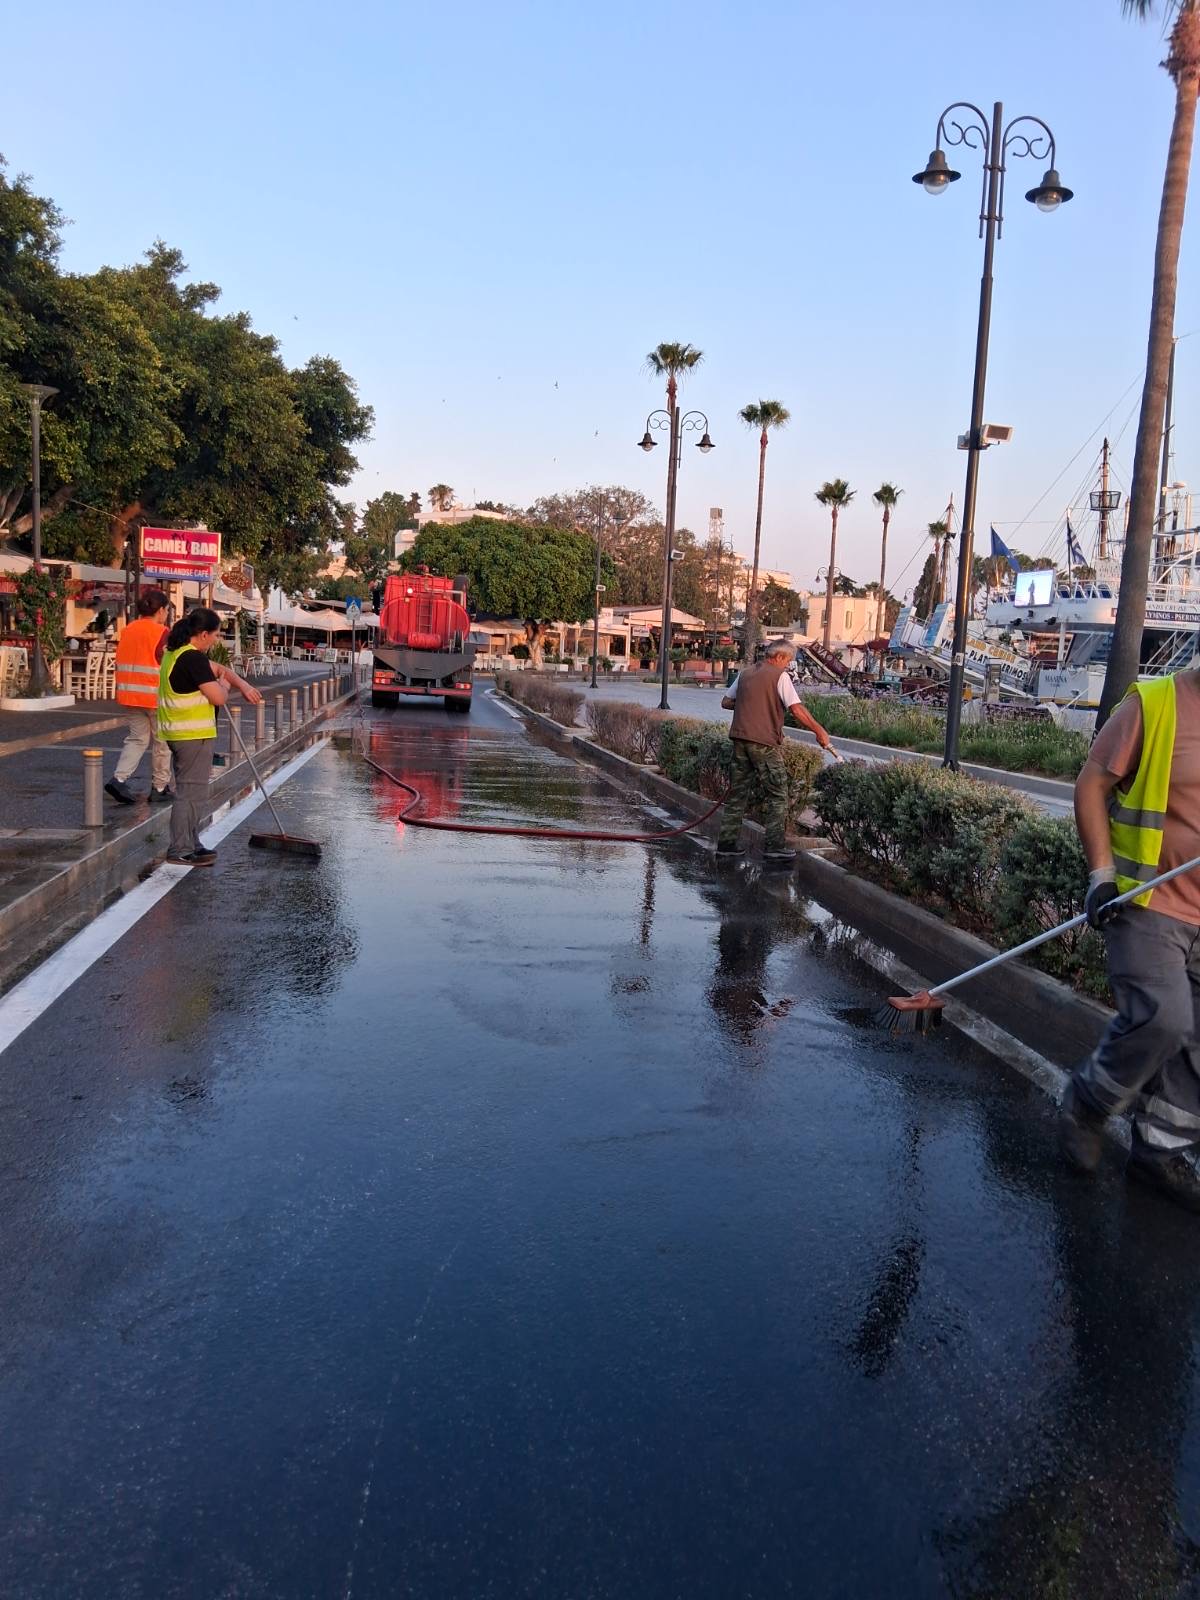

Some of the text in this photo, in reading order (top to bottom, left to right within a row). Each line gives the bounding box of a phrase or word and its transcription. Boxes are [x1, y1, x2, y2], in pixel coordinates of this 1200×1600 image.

[144, 538, 217, 557] CAMEL BAR
[146, 565, 158, 573] HET
[159, 567, 193, 577] HOLLANDSE
[1145, 611, 1171, 620] LYMNOS
[968, 650, 988, 664] PLAT
[1001, 664, 1028, 680] ERIMOS
